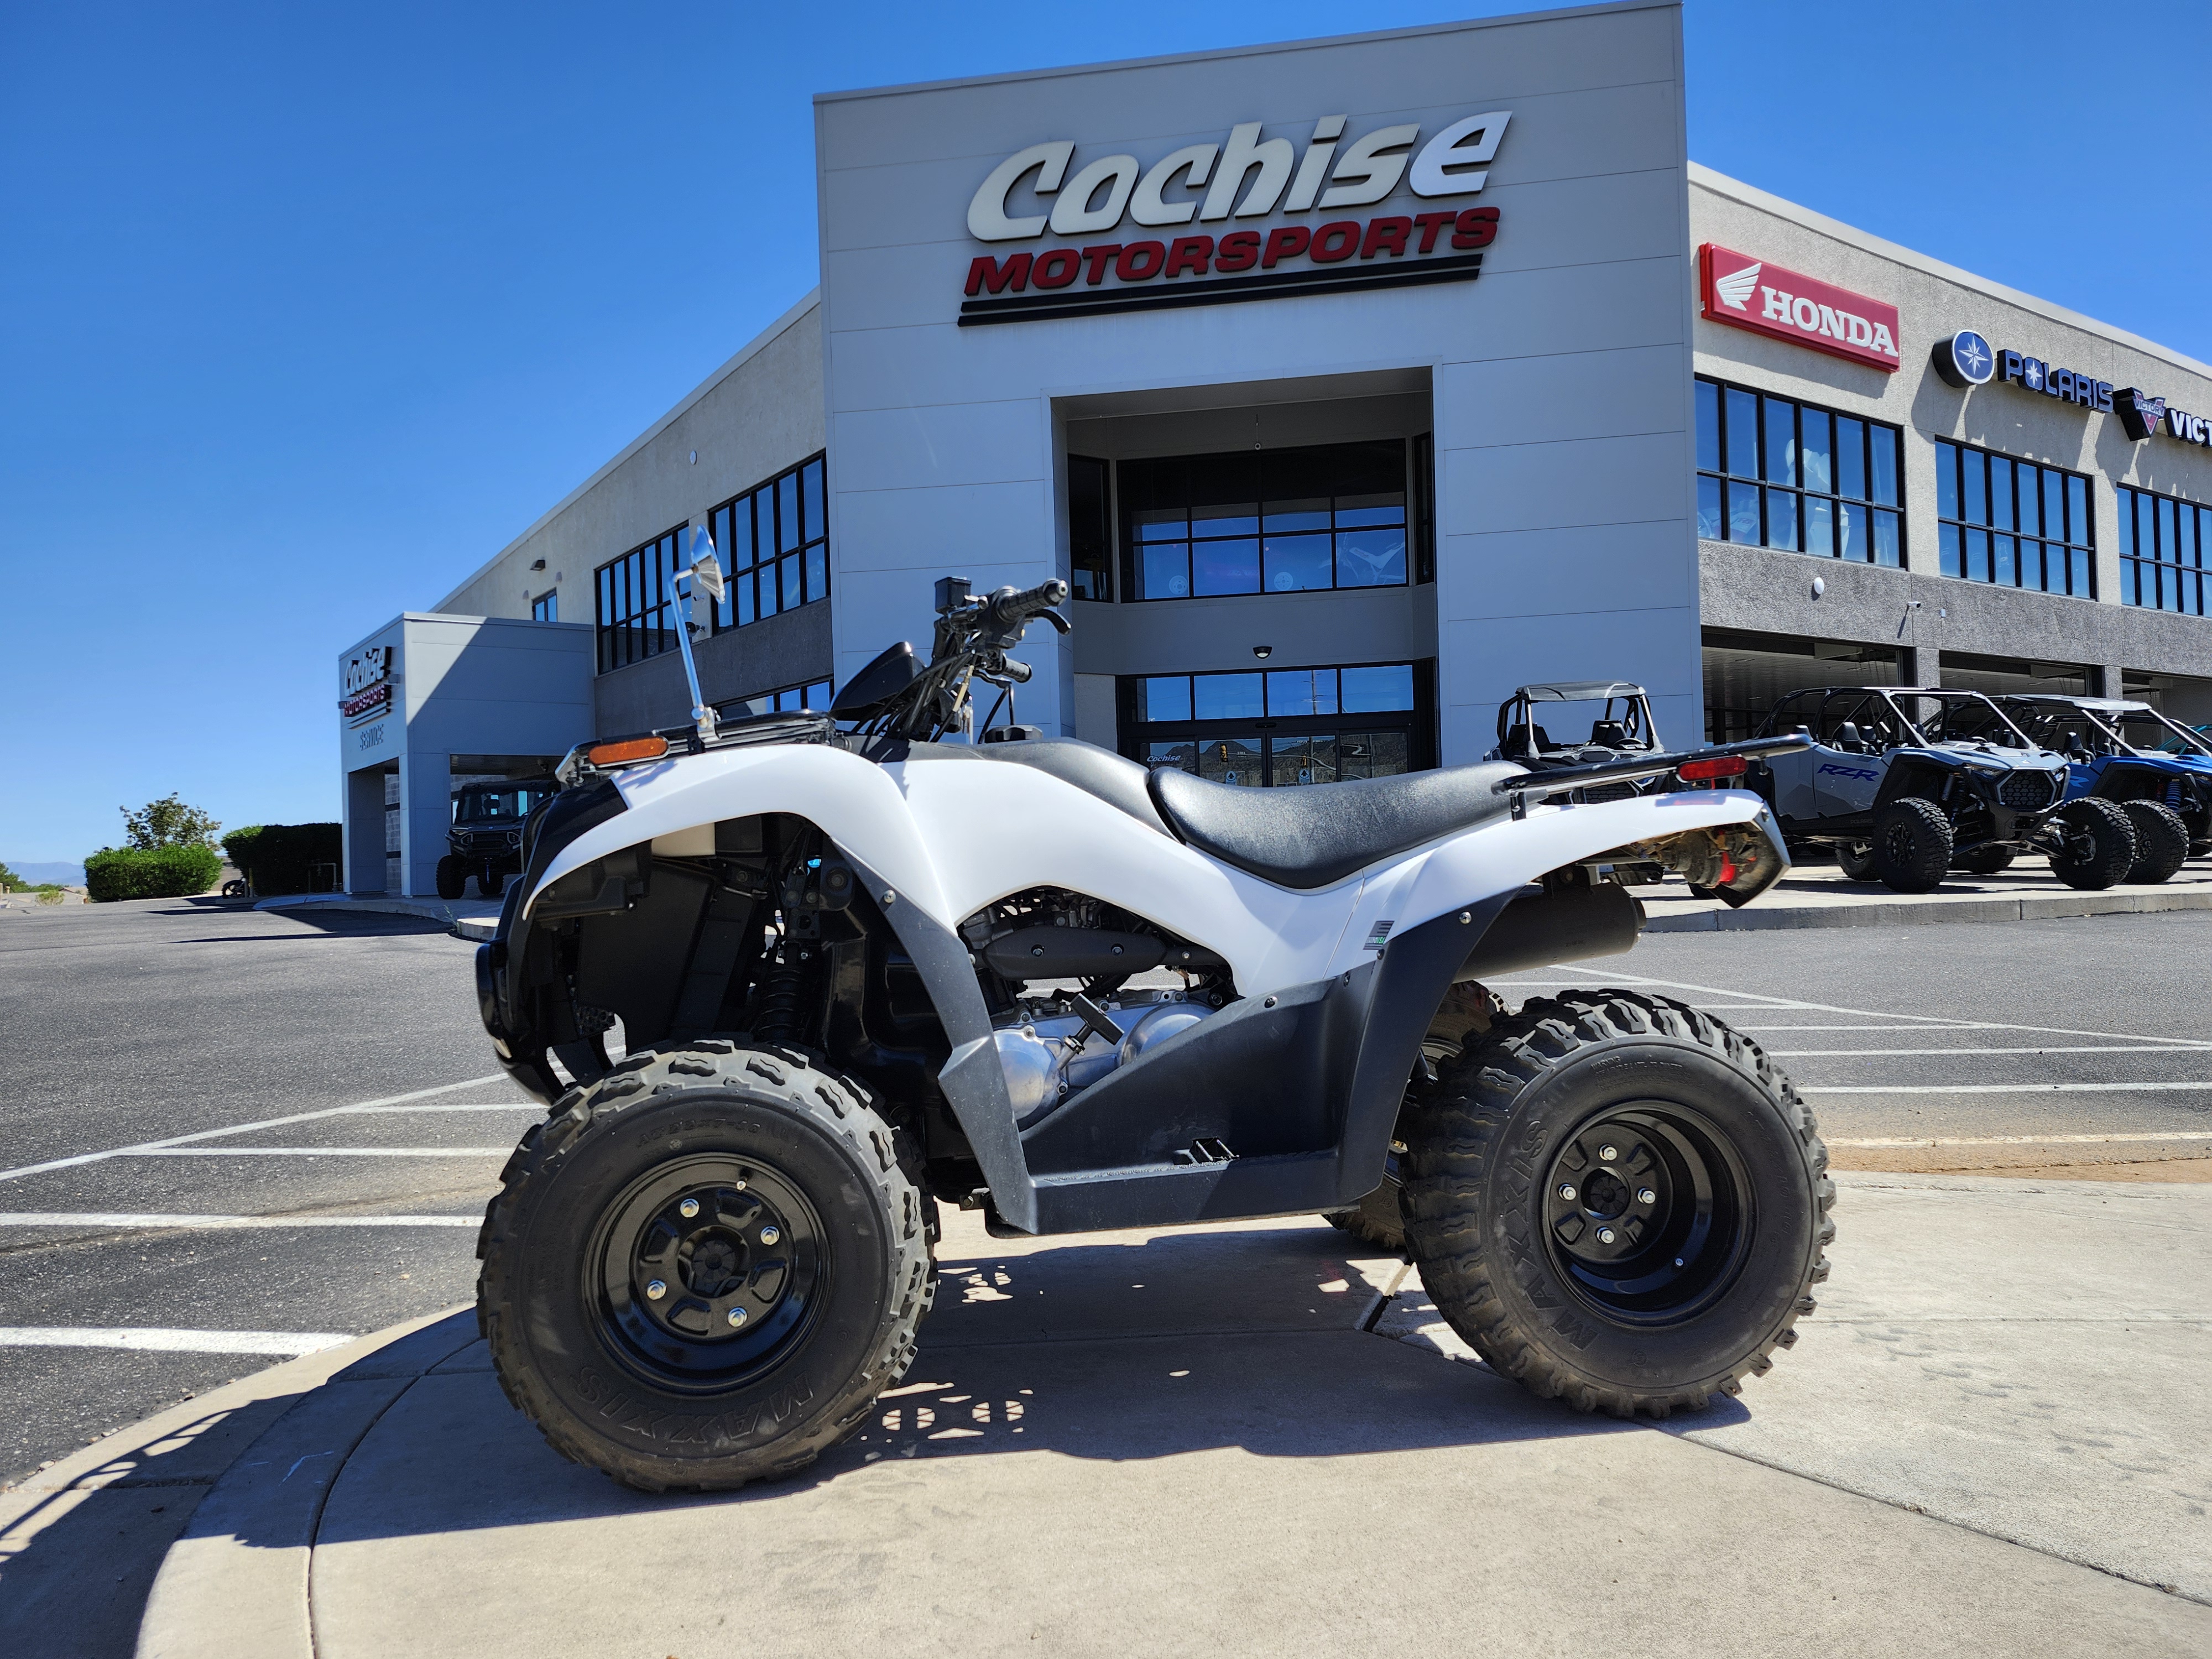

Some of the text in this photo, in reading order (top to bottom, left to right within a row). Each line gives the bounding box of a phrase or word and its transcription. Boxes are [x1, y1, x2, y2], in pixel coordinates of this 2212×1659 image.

[967, 111, 1512, 242] Cochise
[964, 206, 1501, 296] MOTORSPORTS
[1761, 285, 1899, 357] HONDA
[1999, 349, 2114, 413] POLARIS
[2135, 399, 2165, 415] VICTORY
[344, 646, 387, 697] Cochise
[344, 684, 386, 717] MOTORSPORTS
[360, 723, 384, 751] SERVICE
[1817, 763, 1880, 782] RZR
[1504, 1120, 1599, 1352] MAXXIS
[571, 1366, 814, 1443] MAXXIS
